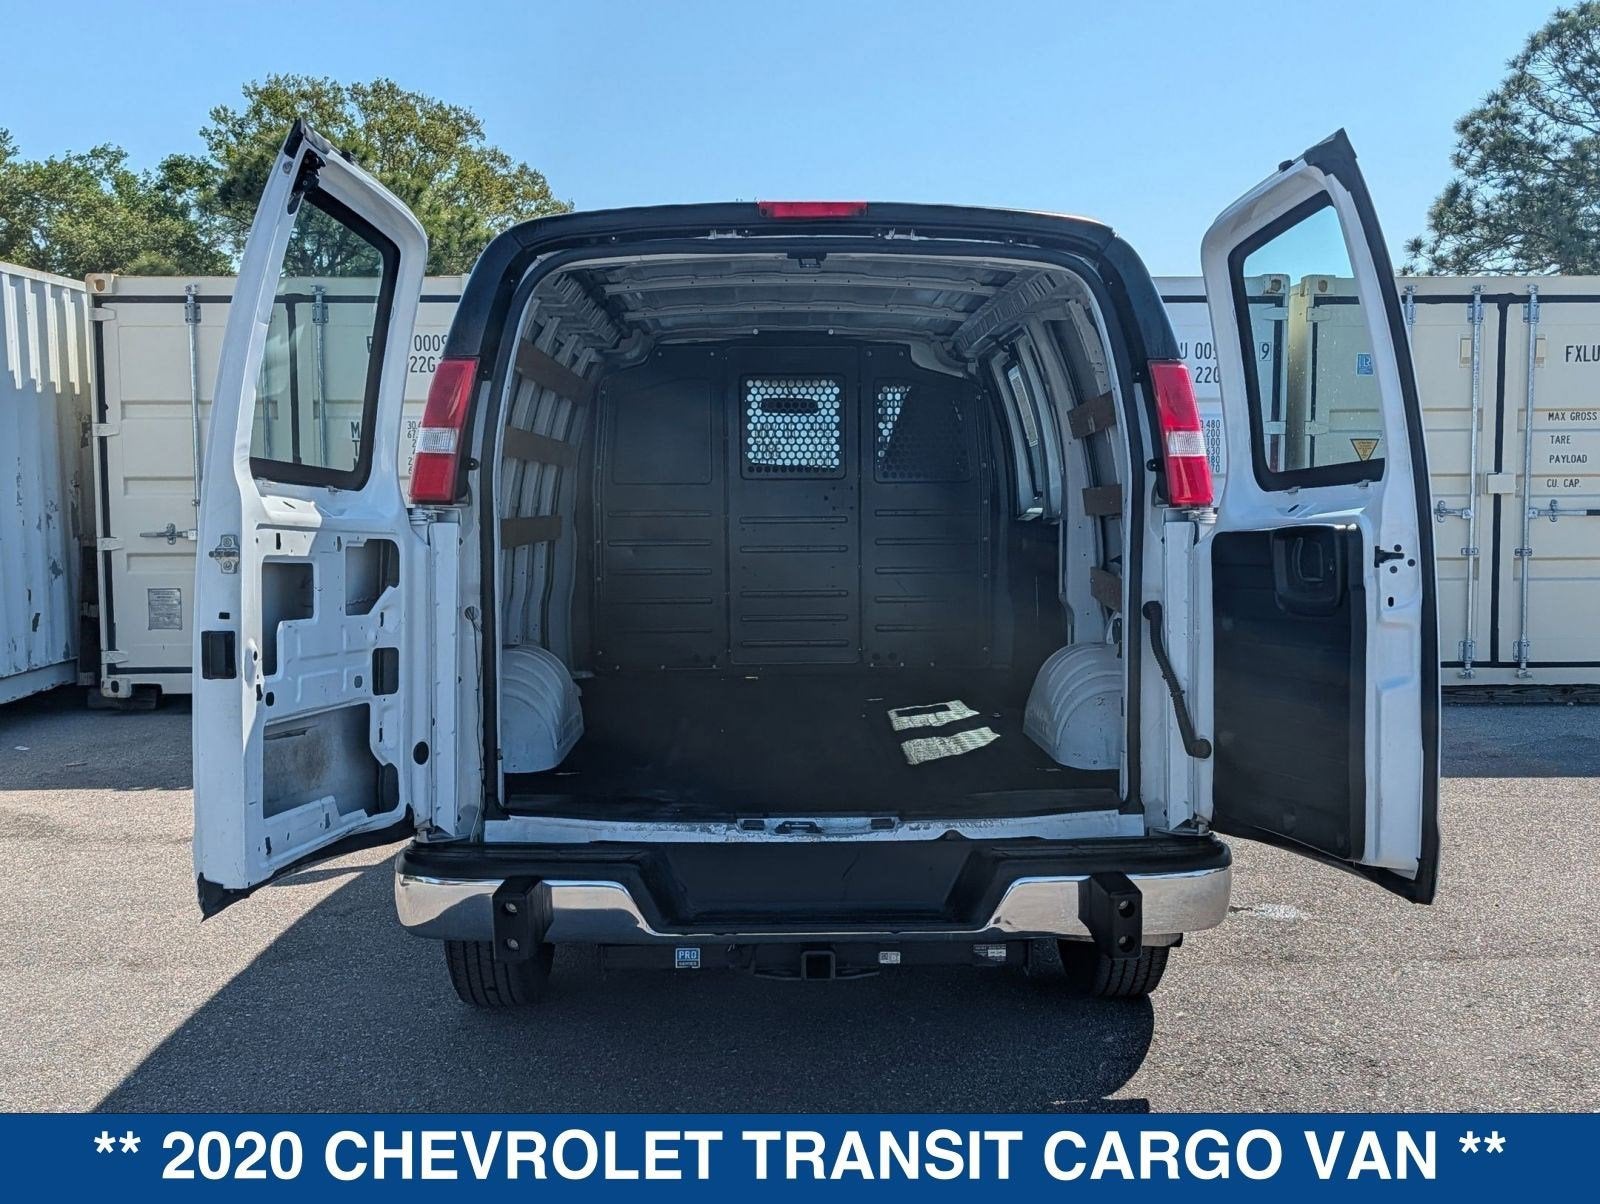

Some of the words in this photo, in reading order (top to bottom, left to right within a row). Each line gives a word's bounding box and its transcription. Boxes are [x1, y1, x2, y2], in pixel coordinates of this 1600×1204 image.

[1565, 345, 1600, 363] FXLU
[409, 356, 444, 373] 22G
[1548, 412, 1566, 421] MAX
[1570, 412, 1598, 421] GROSS
[1550, 435, 1571, 444] TARE
[1549, 455, 1588, 464] PAYLOAD
[1547, 479, 1559, 488] CU.
[1563, 479, 1582, 488] CAP.
[679, 950, 697, 959] PRO
